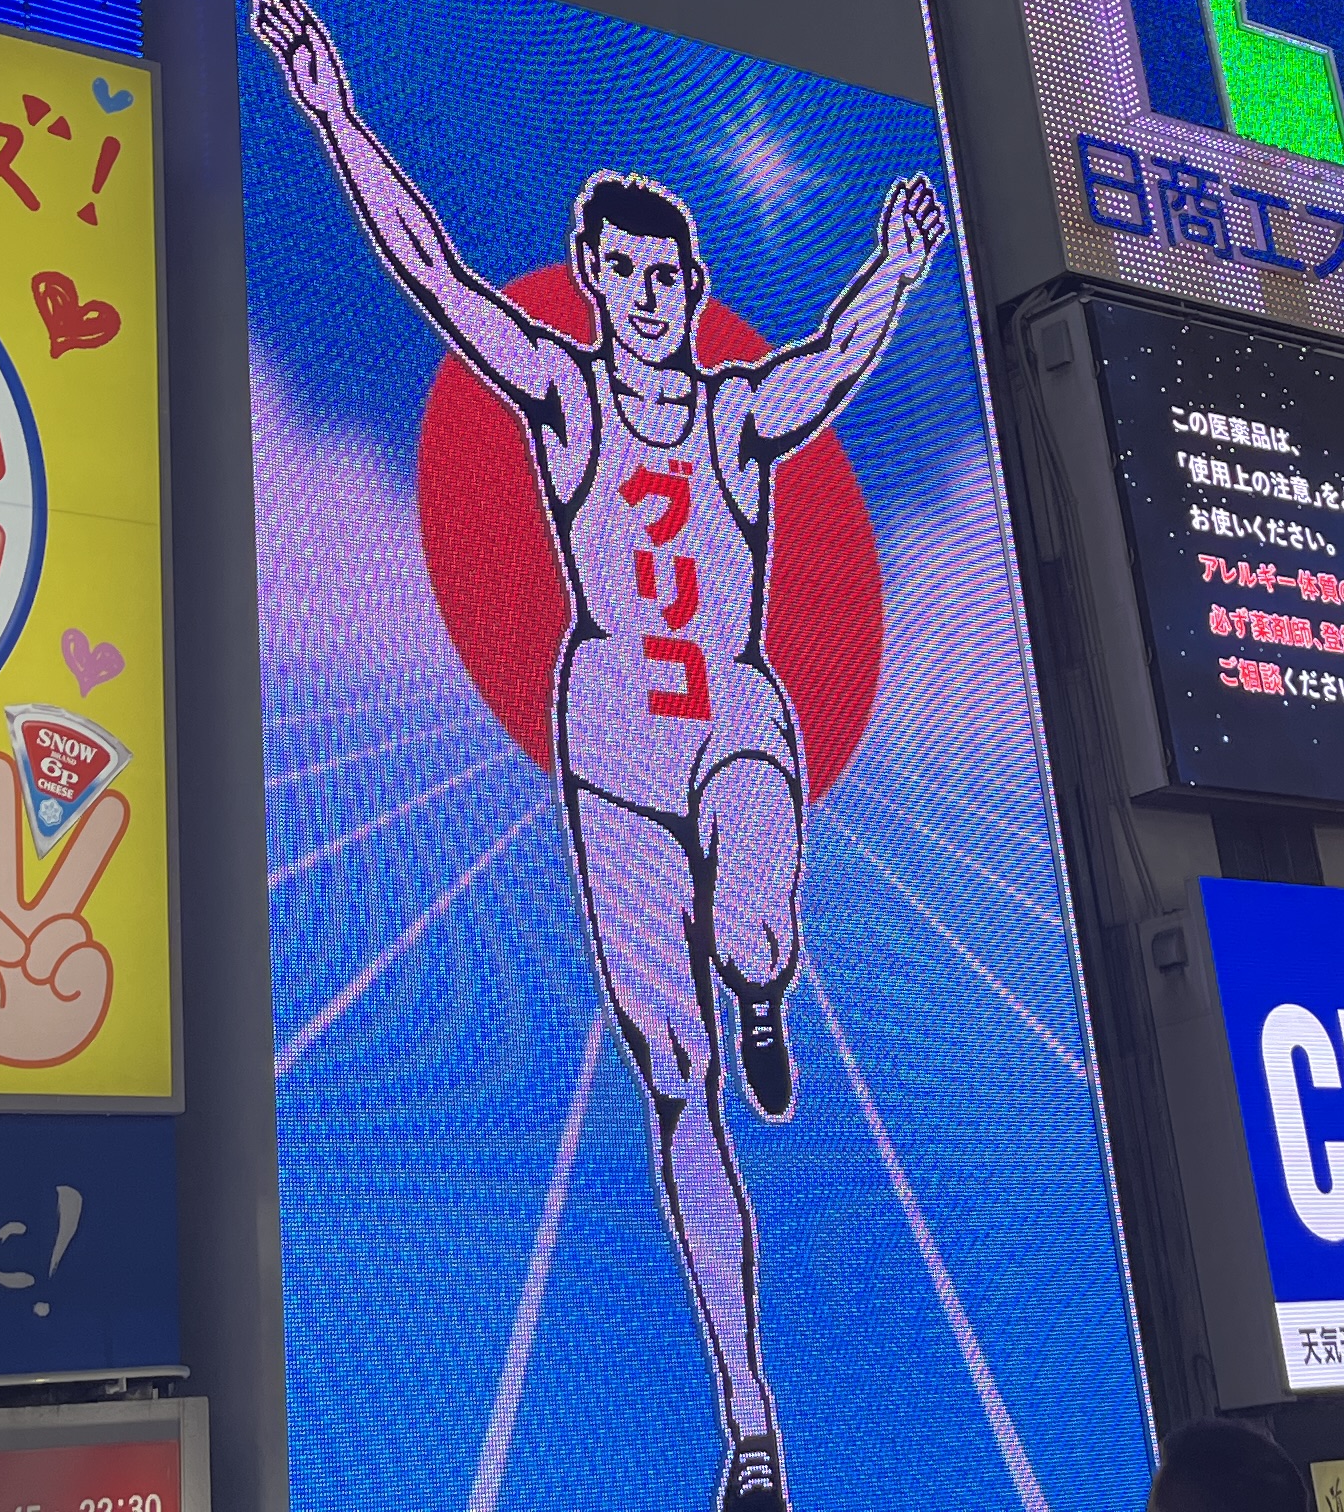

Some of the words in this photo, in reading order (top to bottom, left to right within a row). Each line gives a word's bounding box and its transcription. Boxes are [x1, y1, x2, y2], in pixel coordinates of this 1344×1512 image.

[1170, 406, 1300, 456] この医薬品は、
[1190, 505, 1336, 556] お使いください。
[619, 461, 712, 721] グリコ
[36, 729, 97, 763] SNOW
[38, 778, 74, 799] CHEESE
